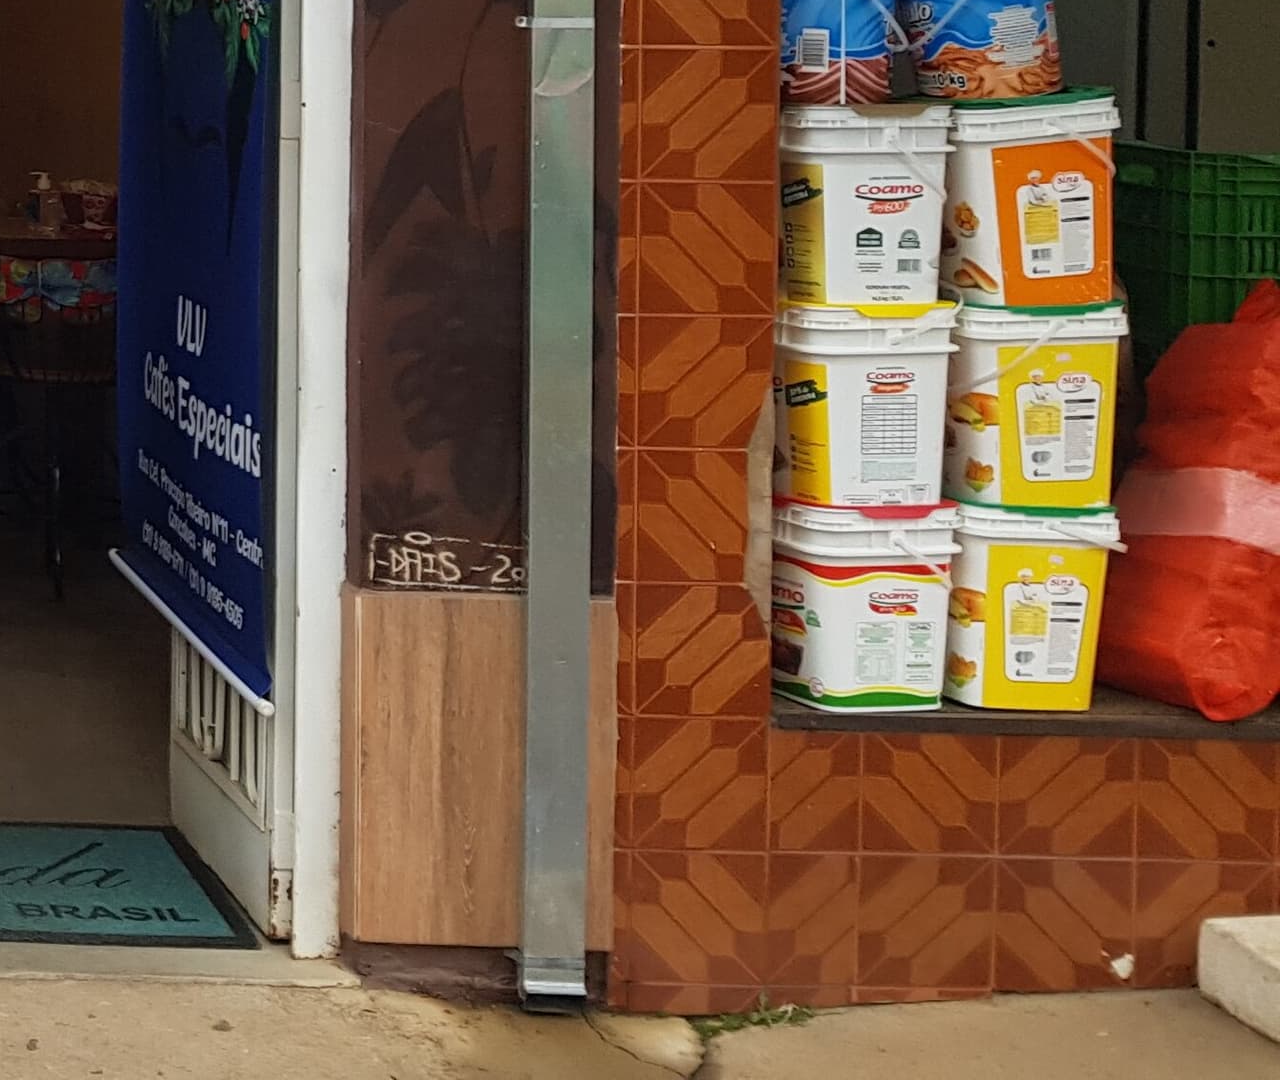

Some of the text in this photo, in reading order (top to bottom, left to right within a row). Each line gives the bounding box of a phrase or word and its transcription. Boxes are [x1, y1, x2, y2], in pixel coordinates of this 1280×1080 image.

[948, 73, 966, 89] kg
[855, 184, 924, 195] Coamo
[866, 372, 915, 381] Coamo
[143, 351, 262, 479] Cafés Especiais
[236, 529, 264, 569] Centr
[868, 591, 919, 600] Coamo
[15, 901, 201, 924] BRASIL
